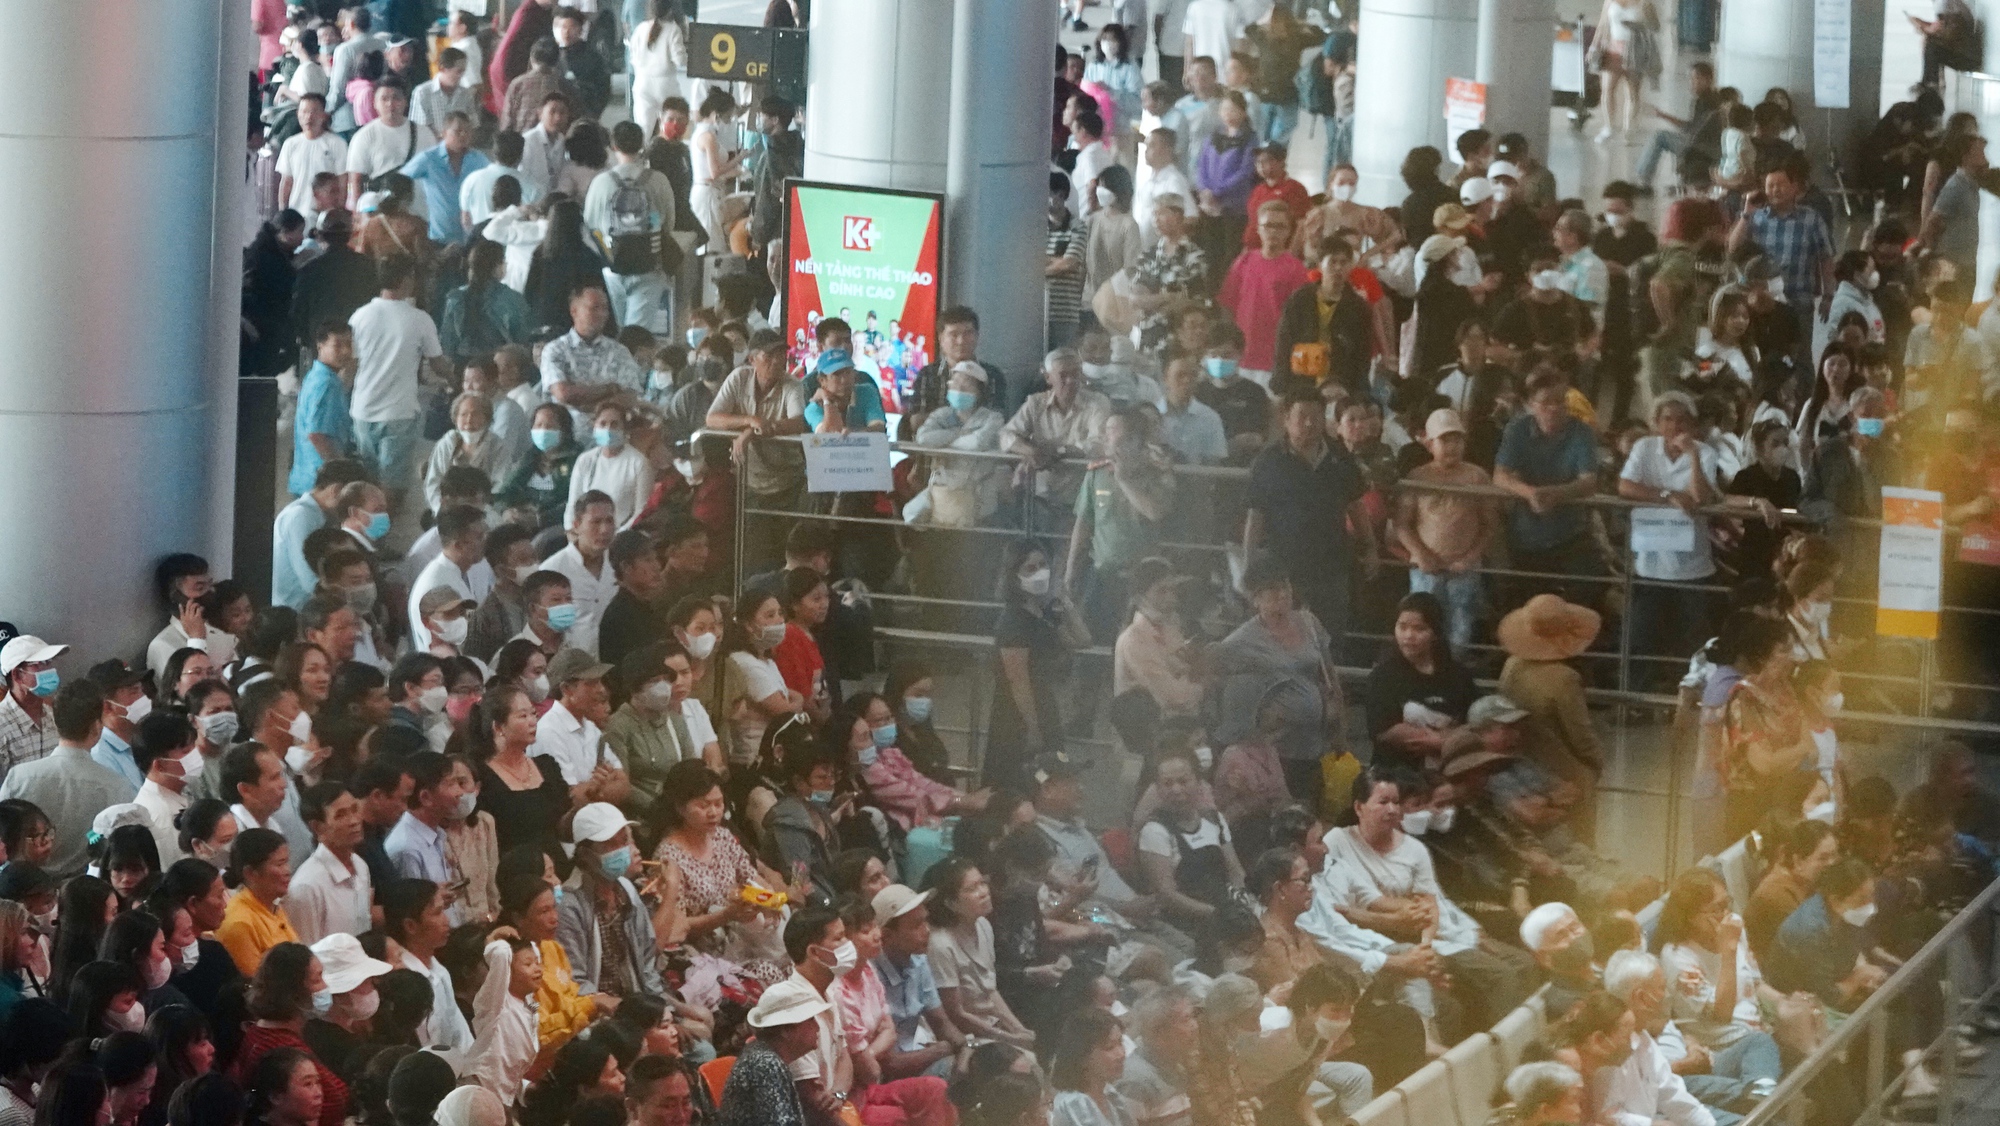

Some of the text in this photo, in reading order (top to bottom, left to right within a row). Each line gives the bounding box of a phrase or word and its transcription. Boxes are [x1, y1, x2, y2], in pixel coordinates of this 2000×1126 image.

[711, 33, 768, 77] 9 GF
[893, 269, 933, 286] THAO
[866, 285, 896, 300] CAO
